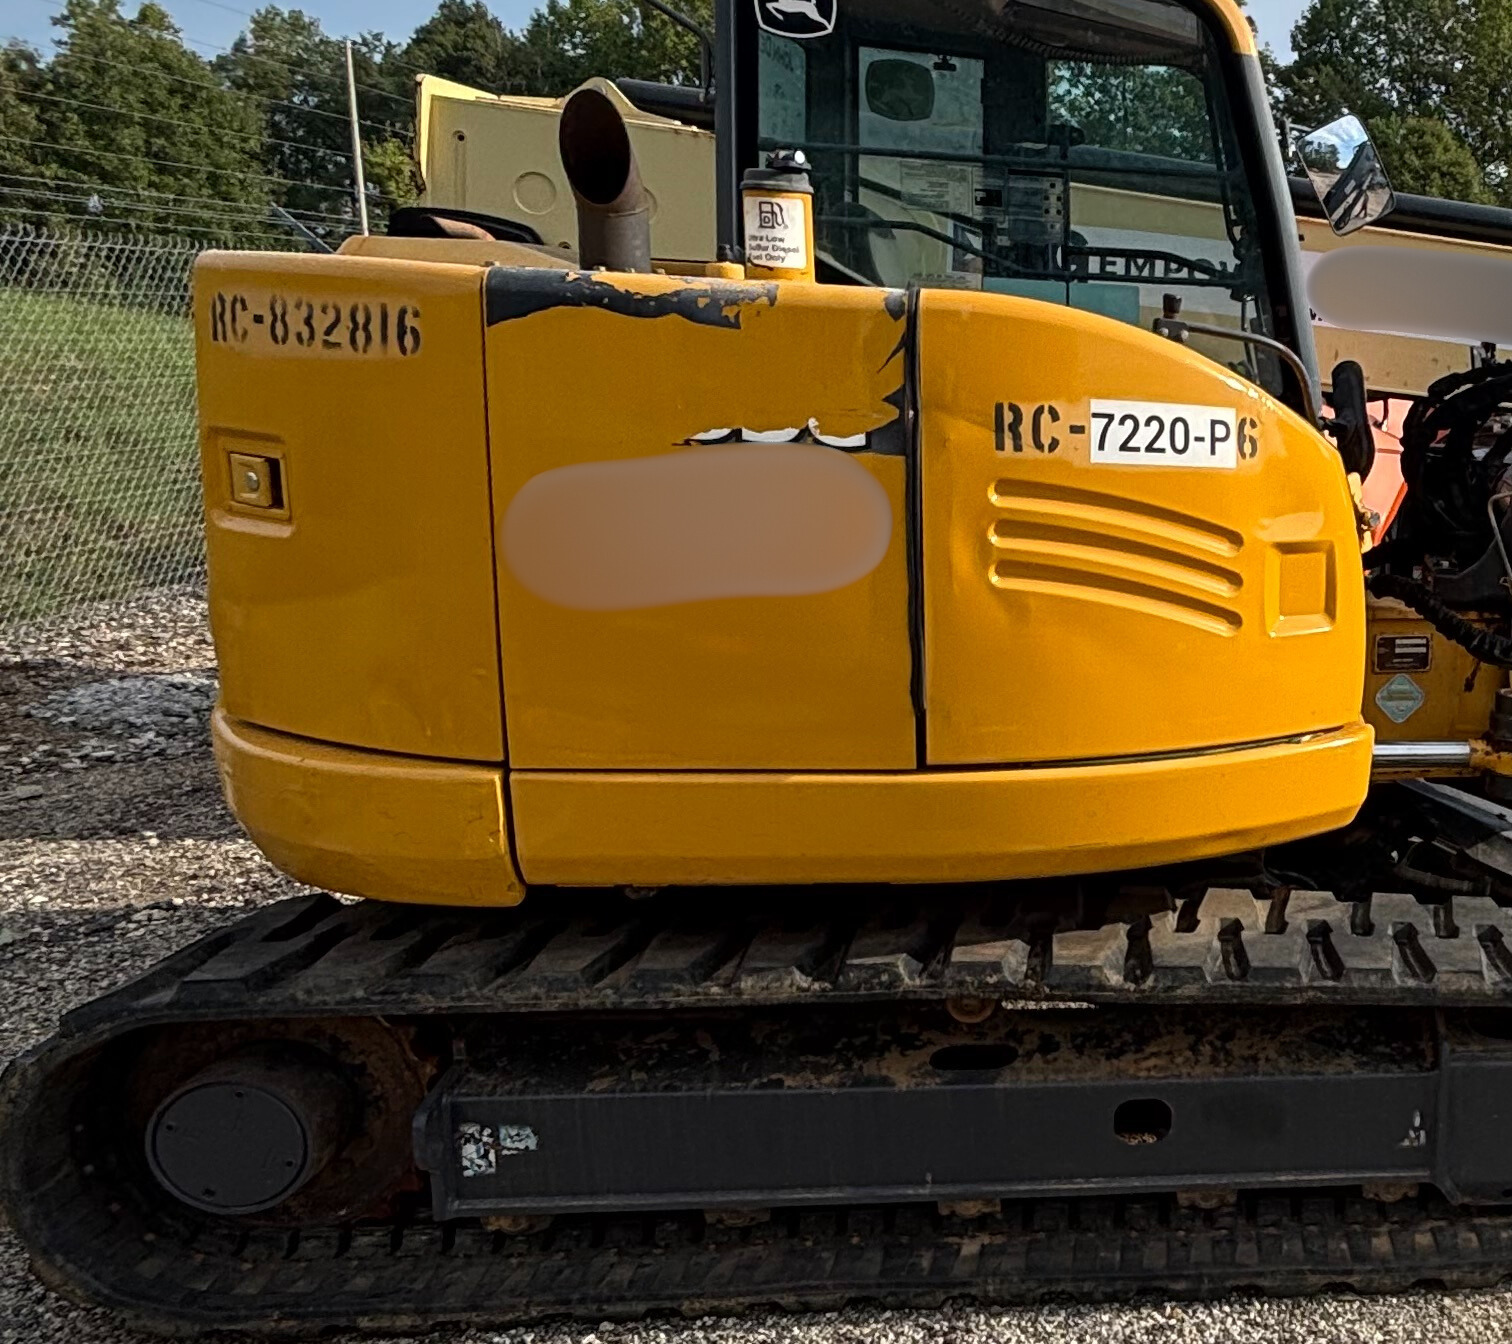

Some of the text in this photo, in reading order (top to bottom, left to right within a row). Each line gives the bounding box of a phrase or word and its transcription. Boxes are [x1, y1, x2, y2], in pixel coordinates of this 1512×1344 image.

[765, 234, 785, 244] Low
[771, 244, 800, 254] Diesel
[764, 253, 786, 264] Only
[210, 292, 422, 356] RC-832816
